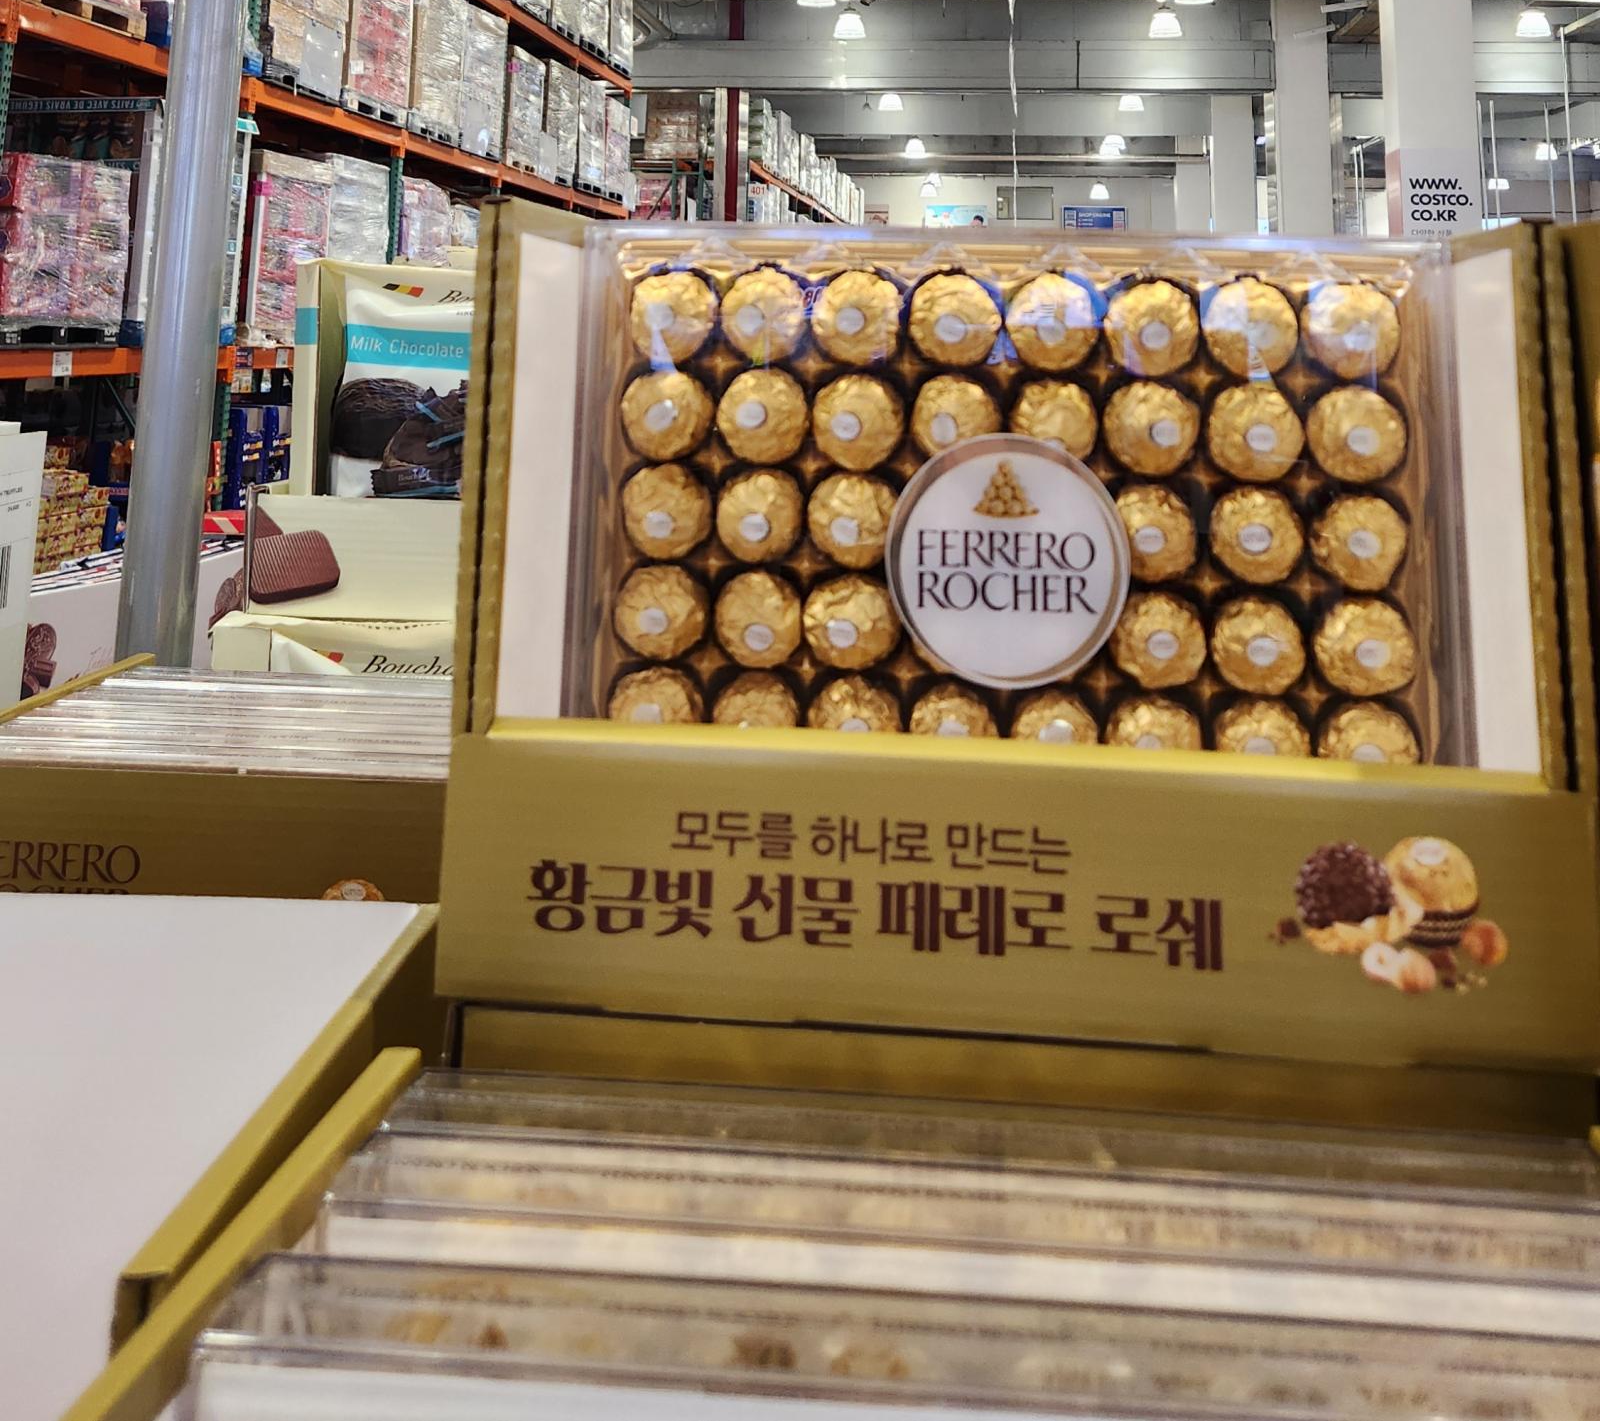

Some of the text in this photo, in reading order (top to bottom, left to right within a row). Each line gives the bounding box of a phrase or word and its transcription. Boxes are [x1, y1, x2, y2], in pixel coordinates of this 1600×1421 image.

[1409, 177, 1462, 190] WWW.
[1410, 193, 1473, 206] COSTCO.
[1411, 209, 1458, 221] CO.KR
[350, 335, 465, 359] Milk Chocolate
[917, 529, 1096, 572] FERRERO
[917, 570, 1098, 614] ROCHER
[361, 654, 454, 676] Boucha
[671, 811, 1072, 875] 모두를 하나로 만드는
[526, 858, 1224, 972] 황금빛 선물 페레로 로쉐
